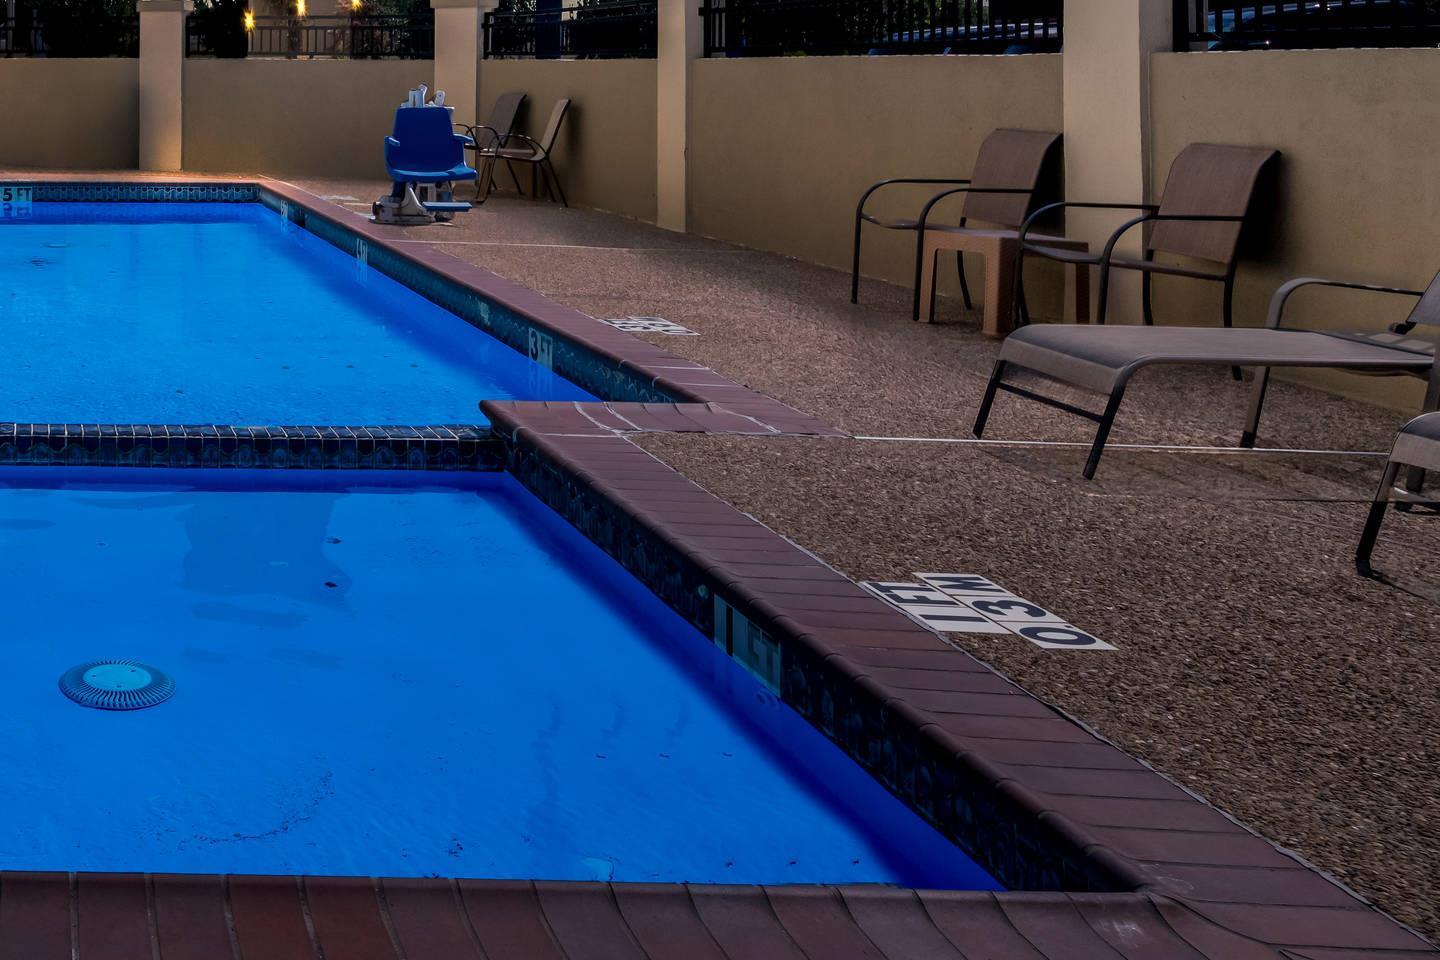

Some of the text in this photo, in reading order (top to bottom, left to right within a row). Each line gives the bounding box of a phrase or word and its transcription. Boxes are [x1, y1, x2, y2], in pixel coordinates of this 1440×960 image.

[2, 187, 32, 202] 5 FT
[530, 329, 539, 361] 3
